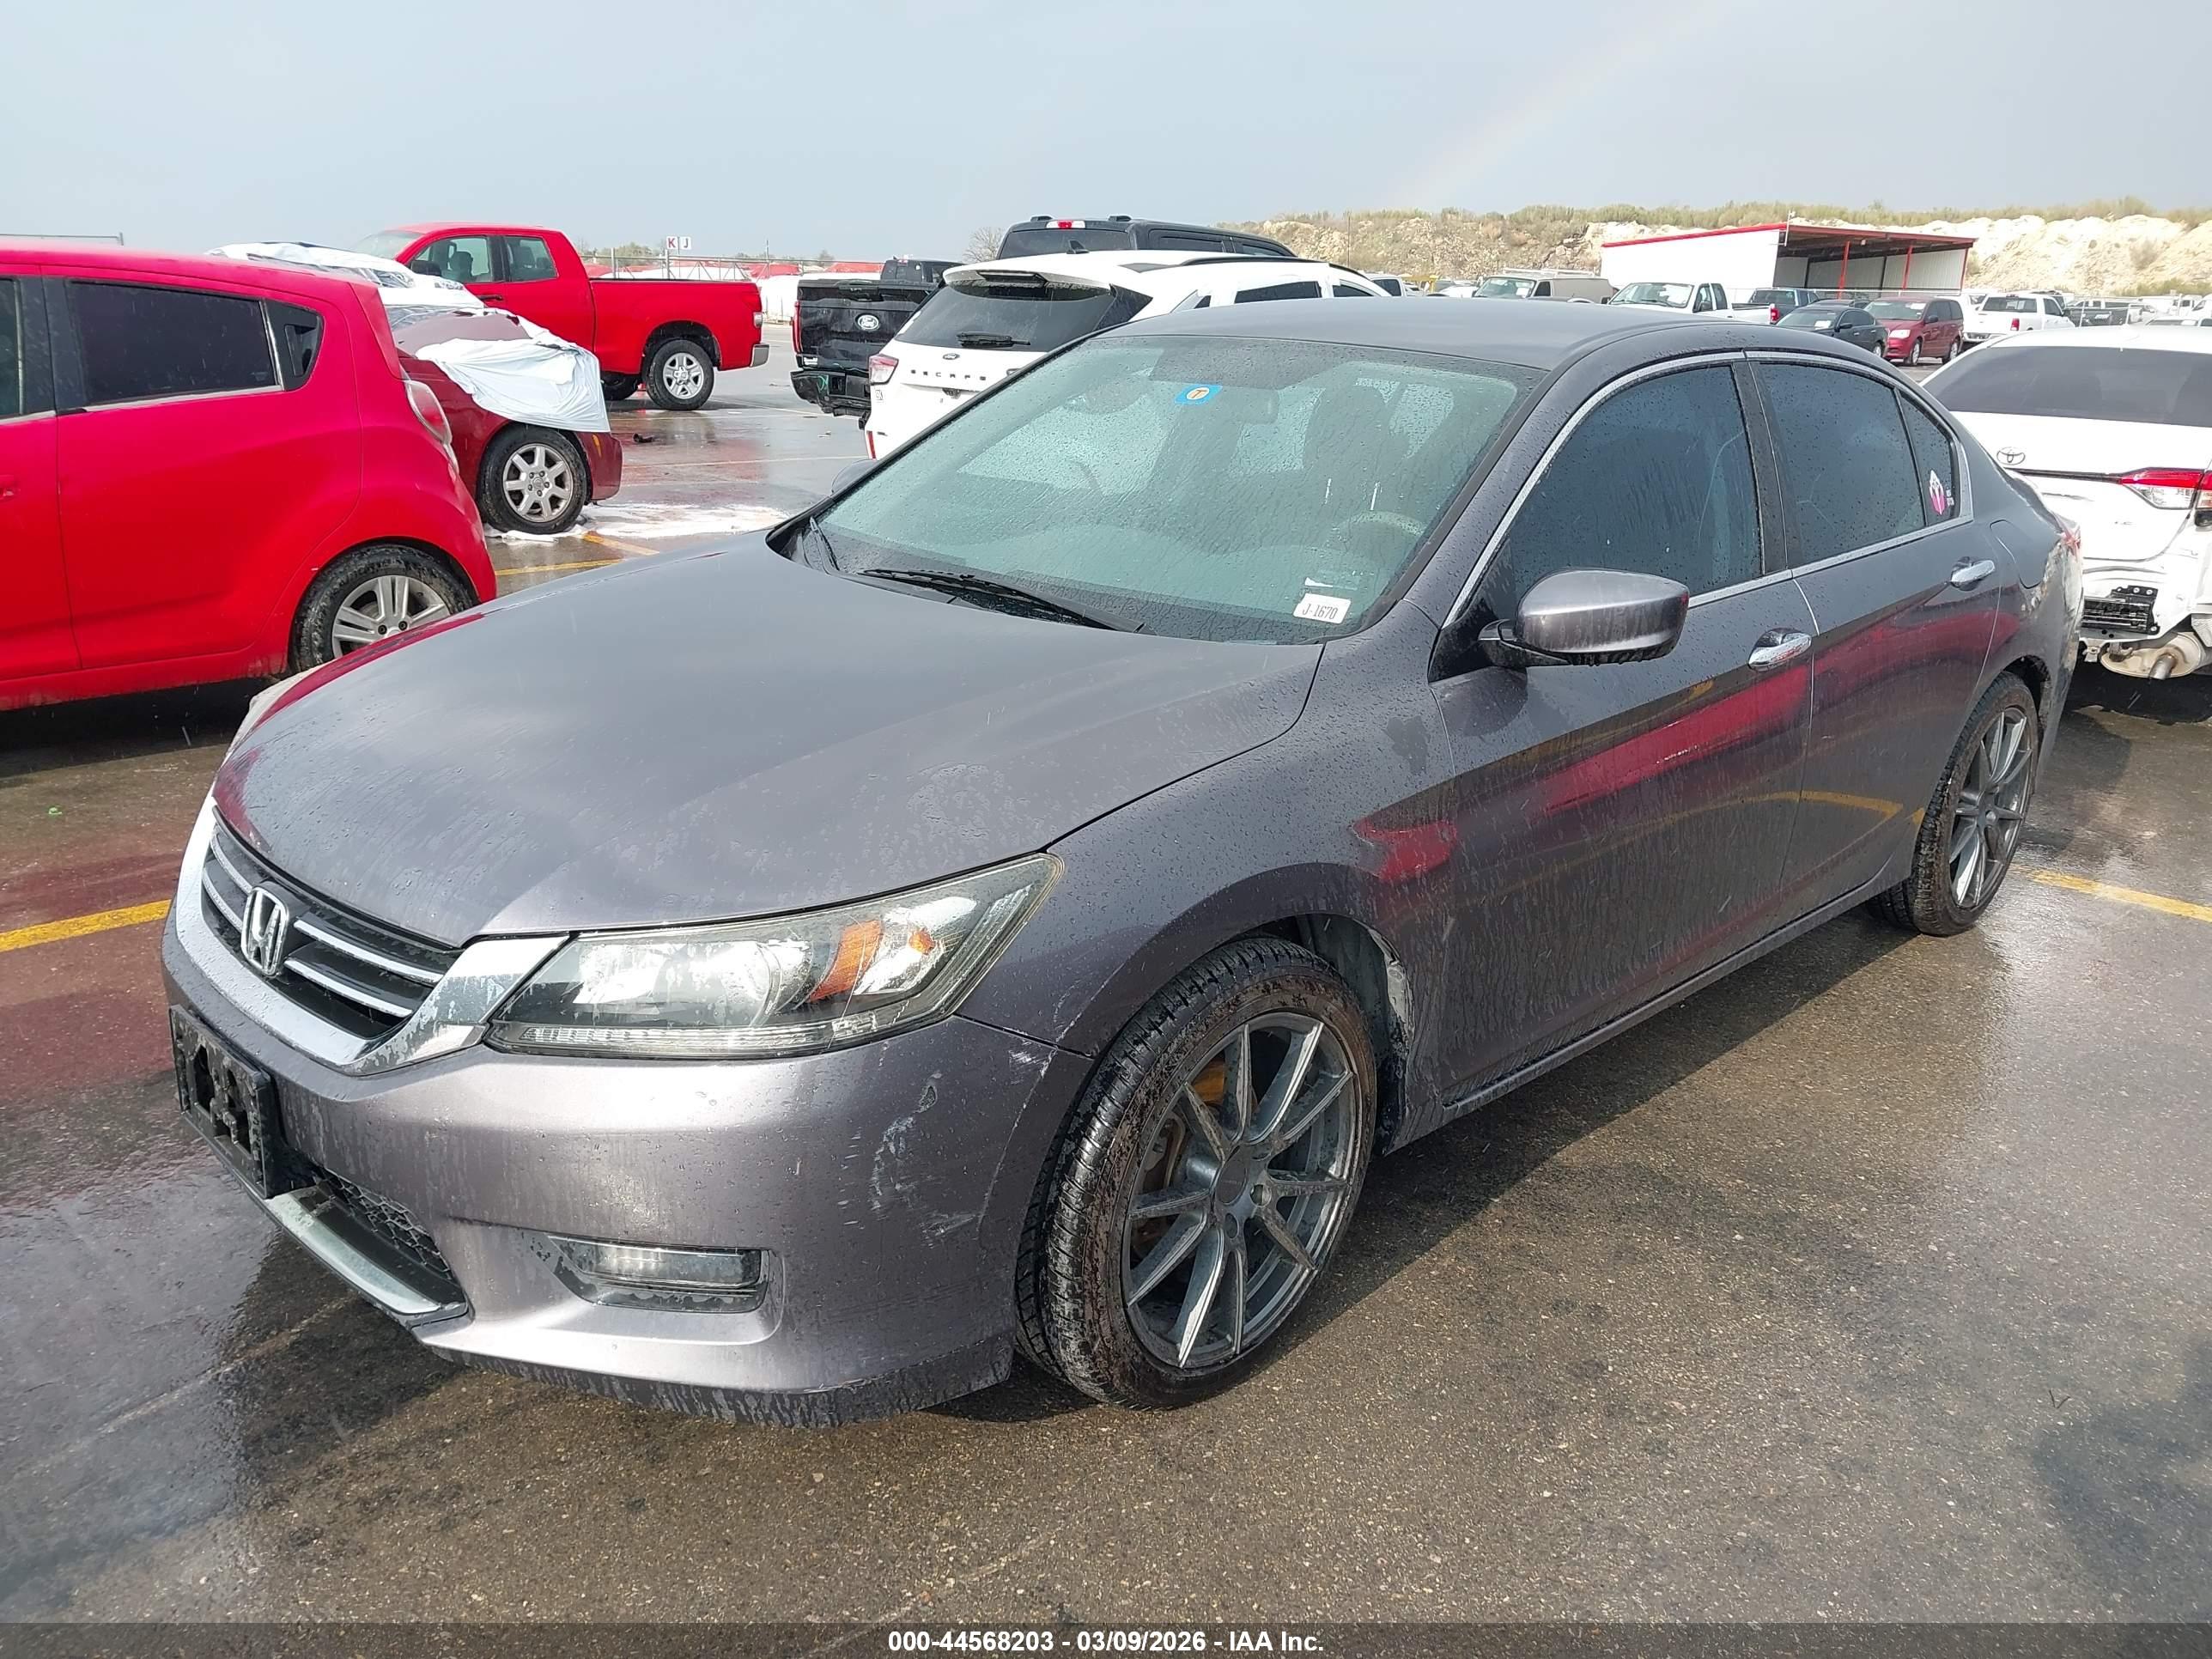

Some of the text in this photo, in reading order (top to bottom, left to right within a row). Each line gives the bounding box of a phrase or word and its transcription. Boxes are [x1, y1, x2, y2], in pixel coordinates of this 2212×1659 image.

[667, 237, 677, 248] K
[683, 237, 689, 248] J
[1302, 603, 1339, 620] J-1670
